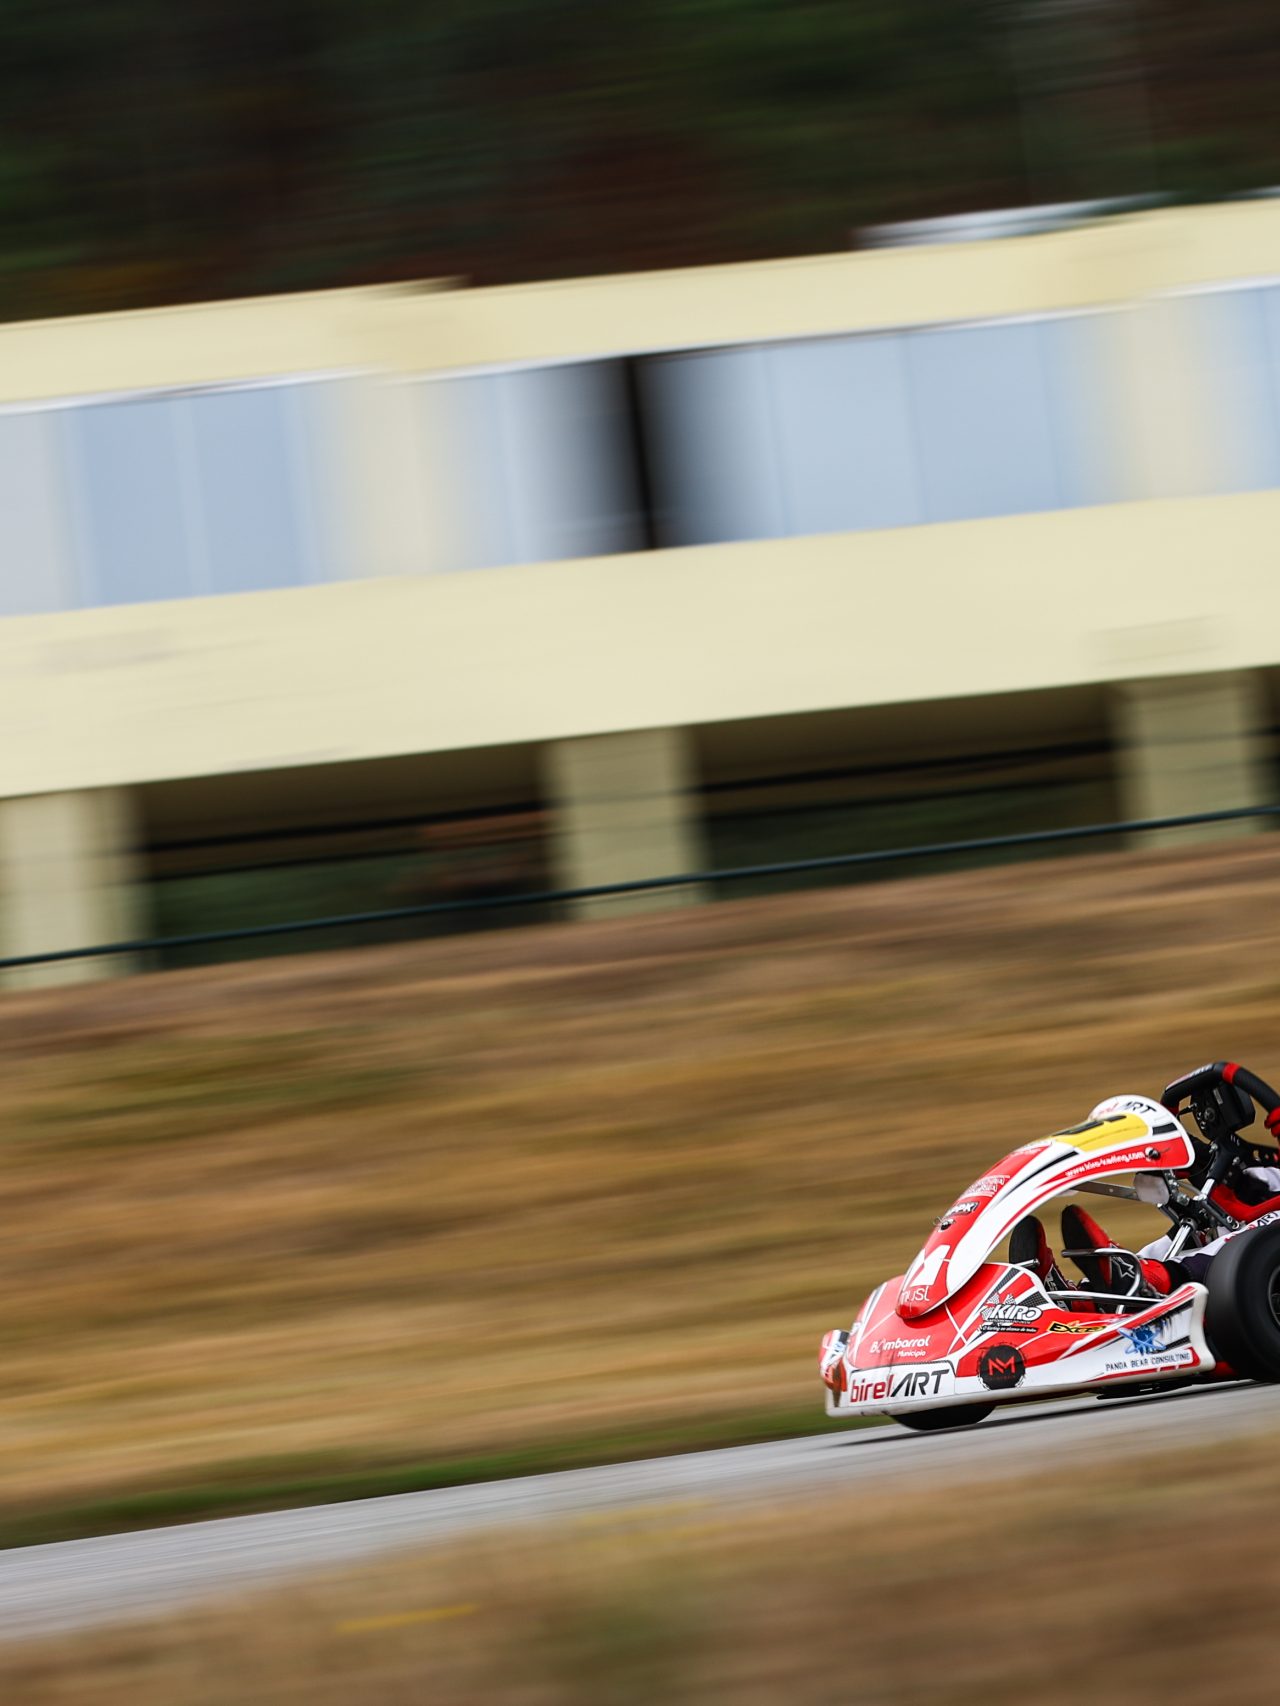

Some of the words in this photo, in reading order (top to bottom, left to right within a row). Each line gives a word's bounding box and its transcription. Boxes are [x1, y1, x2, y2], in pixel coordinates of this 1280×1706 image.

[989, 1304, 1043, 1321] KIRO
[1105, 1361, 1127, 1371] PANDA
[1131, 1358, 1149, 1368] BEAR
[1151, 1352, 1190, 1365] CONSULTING
[851, 1369, 950, 1403] birelART
